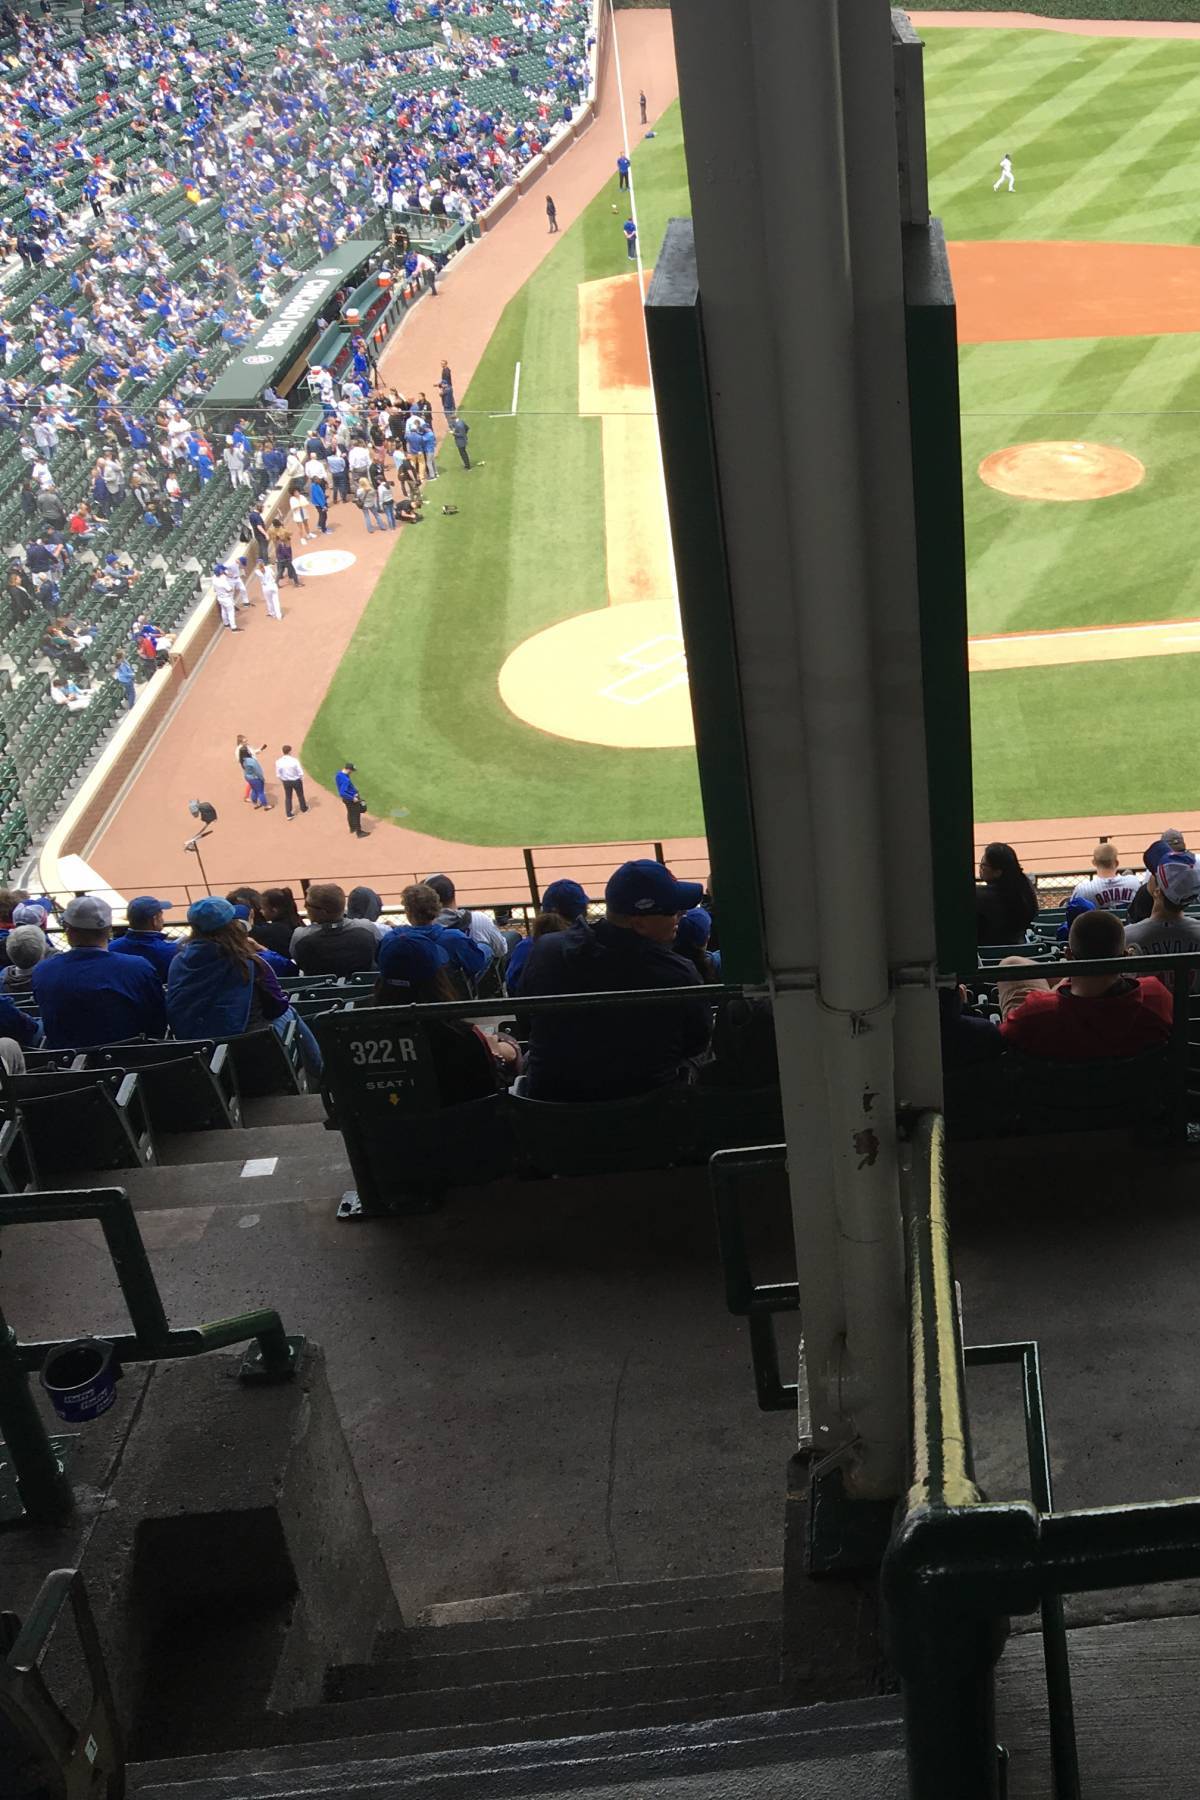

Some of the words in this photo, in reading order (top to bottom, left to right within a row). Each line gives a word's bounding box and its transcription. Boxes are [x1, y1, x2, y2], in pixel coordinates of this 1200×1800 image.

[280, 279, 331, 320] CHICAGO
[256, 320, 299, 348] CUBS
[350, 1040, 396, 1065] 322
[398, 1038, 418, 1062] R
[366, 1080, 404, 1090] SEAT
